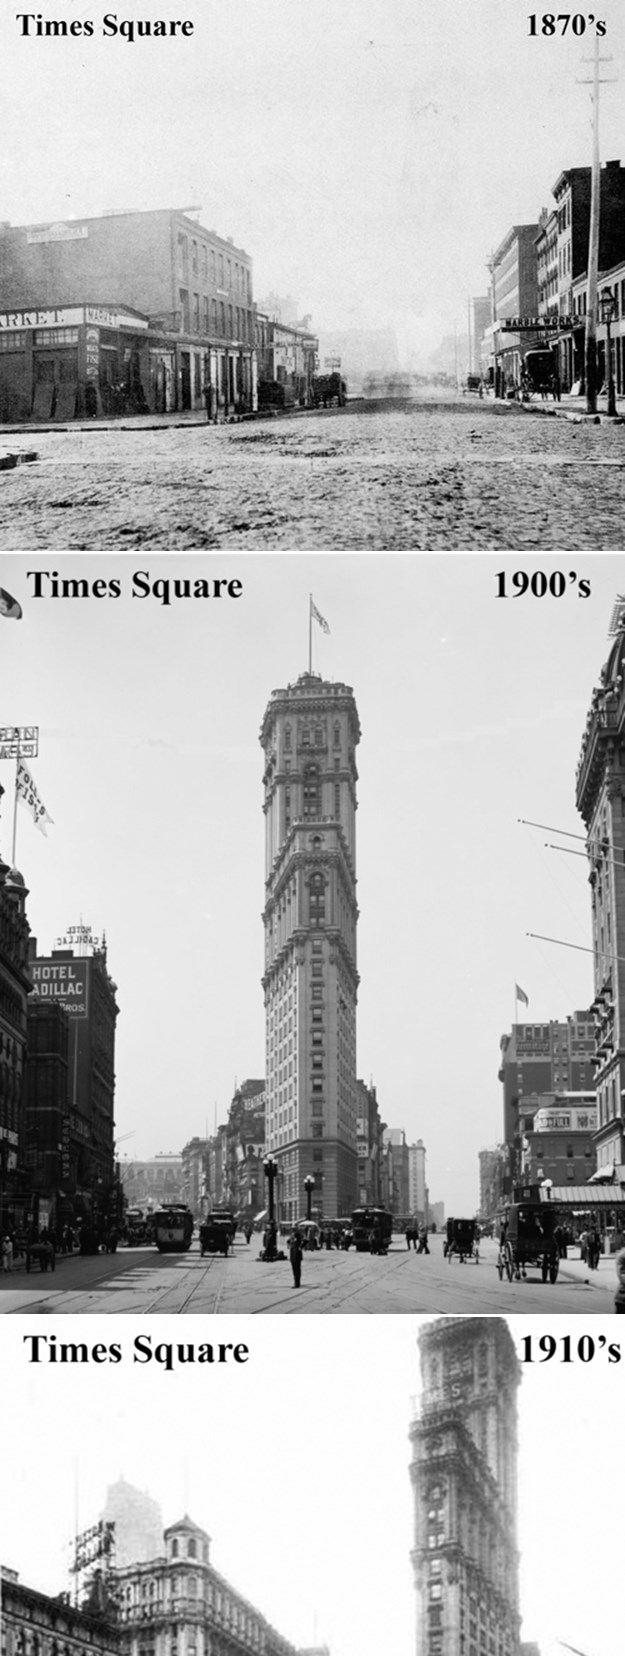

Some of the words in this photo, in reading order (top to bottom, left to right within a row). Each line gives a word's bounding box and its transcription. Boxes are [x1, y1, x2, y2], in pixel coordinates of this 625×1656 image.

[505, 317, 540, 327] MARBLE
[544, 315, 580, 325] WORKS
[32, 966, 76, 980] HOTEL
[27, 983, 84, 996] ADILLAC
